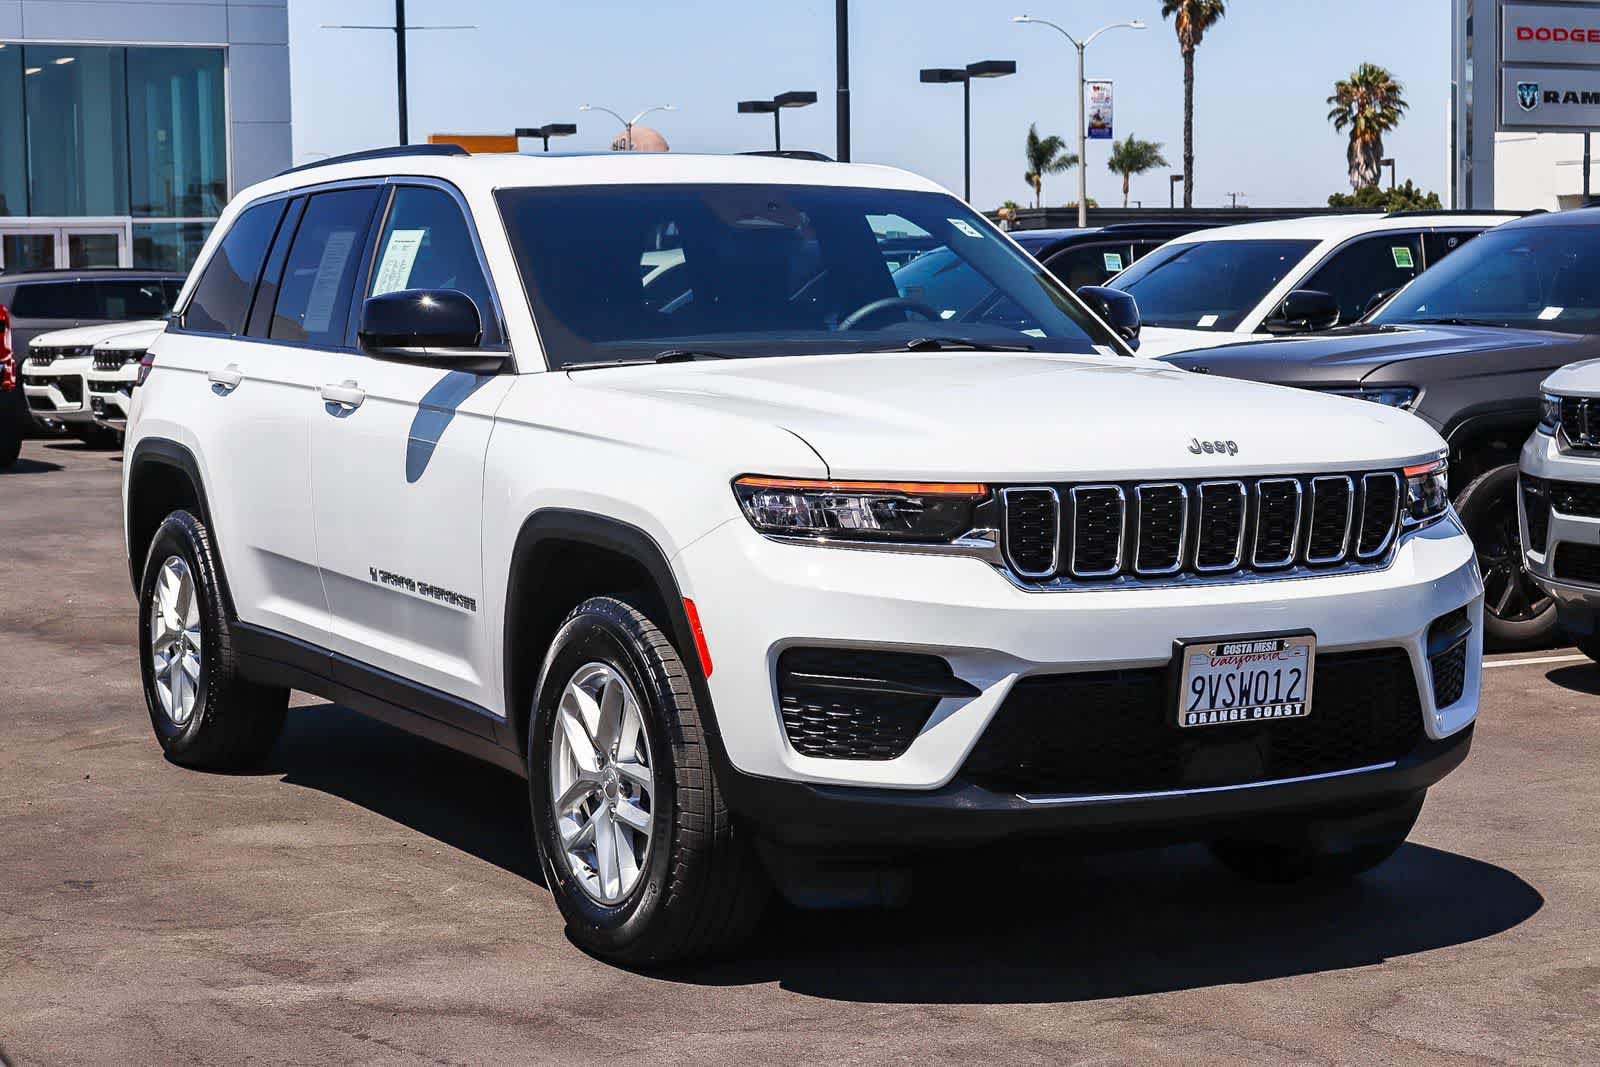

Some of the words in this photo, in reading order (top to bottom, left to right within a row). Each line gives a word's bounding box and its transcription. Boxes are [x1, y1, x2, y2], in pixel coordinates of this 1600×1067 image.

[1516, 26, 1600, 42] DODGE
[1543, 90, 1600, 104] RAM
[1187, 437, 1239, 456] Jeep
[1223, 643, 1252, 655] COSTA
[1253, 641, 1277, 653] MESA
[1189, 667, 1302, 712] 9VSW012
[1188, 708, 1248, 724] ORANGE
[1253, 703, 1302, 718] COAST
